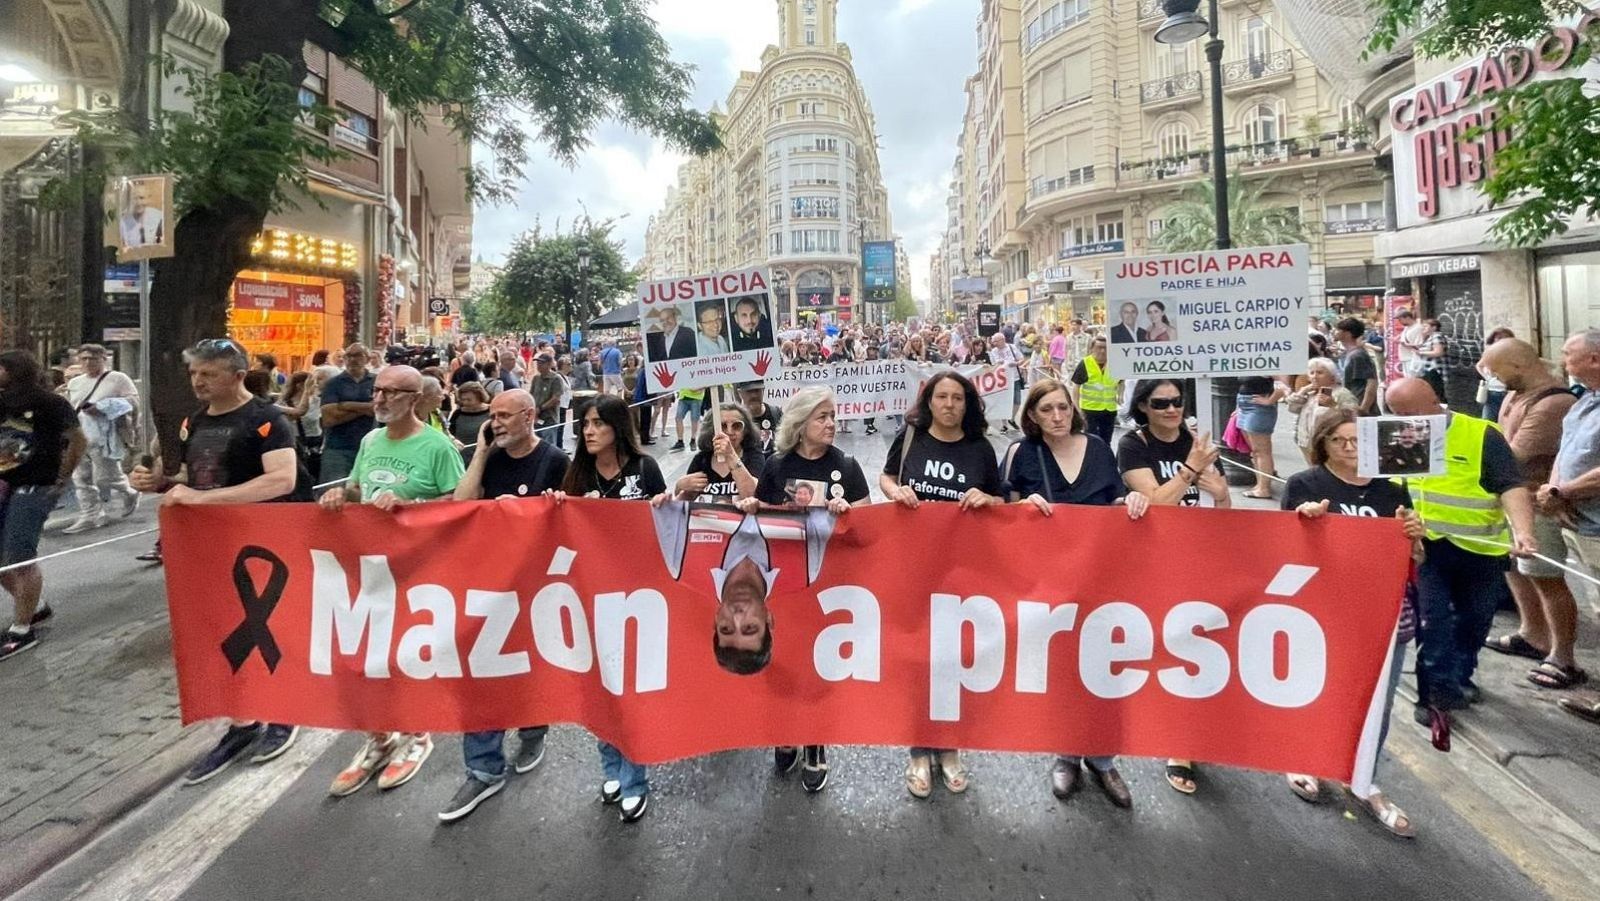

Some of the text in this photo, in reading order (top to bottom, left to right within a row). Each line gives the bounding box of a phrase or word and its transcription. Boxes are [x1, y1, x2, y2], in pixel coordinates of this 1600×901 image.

[1227, 251, 1293, 271] PARA
[1401, 256, 1477, 276] DAVID KEBAB
[642, 271, 767, 304] JUSTICIA
[1161, 276, 1246, 290] PADRE E HIJA
[1179, 297, 1303, 316] MIGUEL CARPIO Y
[1193, 316, 1289, 332] SARA CARPIO
[1122, 341, 1292, 357] Y TODAS LAS VICTIMAS
[681, 352, 743, 368] por mi marido
[1133, 355, 1280, 373] MAZÓN PRISIÓN
[689, 365, 737, 378] y mis hijos
[835, 364, 906, 377] FAMILIARES
[767, 388, 789, 399] HAN
[836, 384, 858, 394] POR
[861, 381, 906, 393] VUESTRA
[837, 400, 886, 414] TENCIA
[924, 459, 965, 484] NO a
[909, 477, 966, 501] l'aforame
[309, 546, 1327, 721] Mazón a presó
